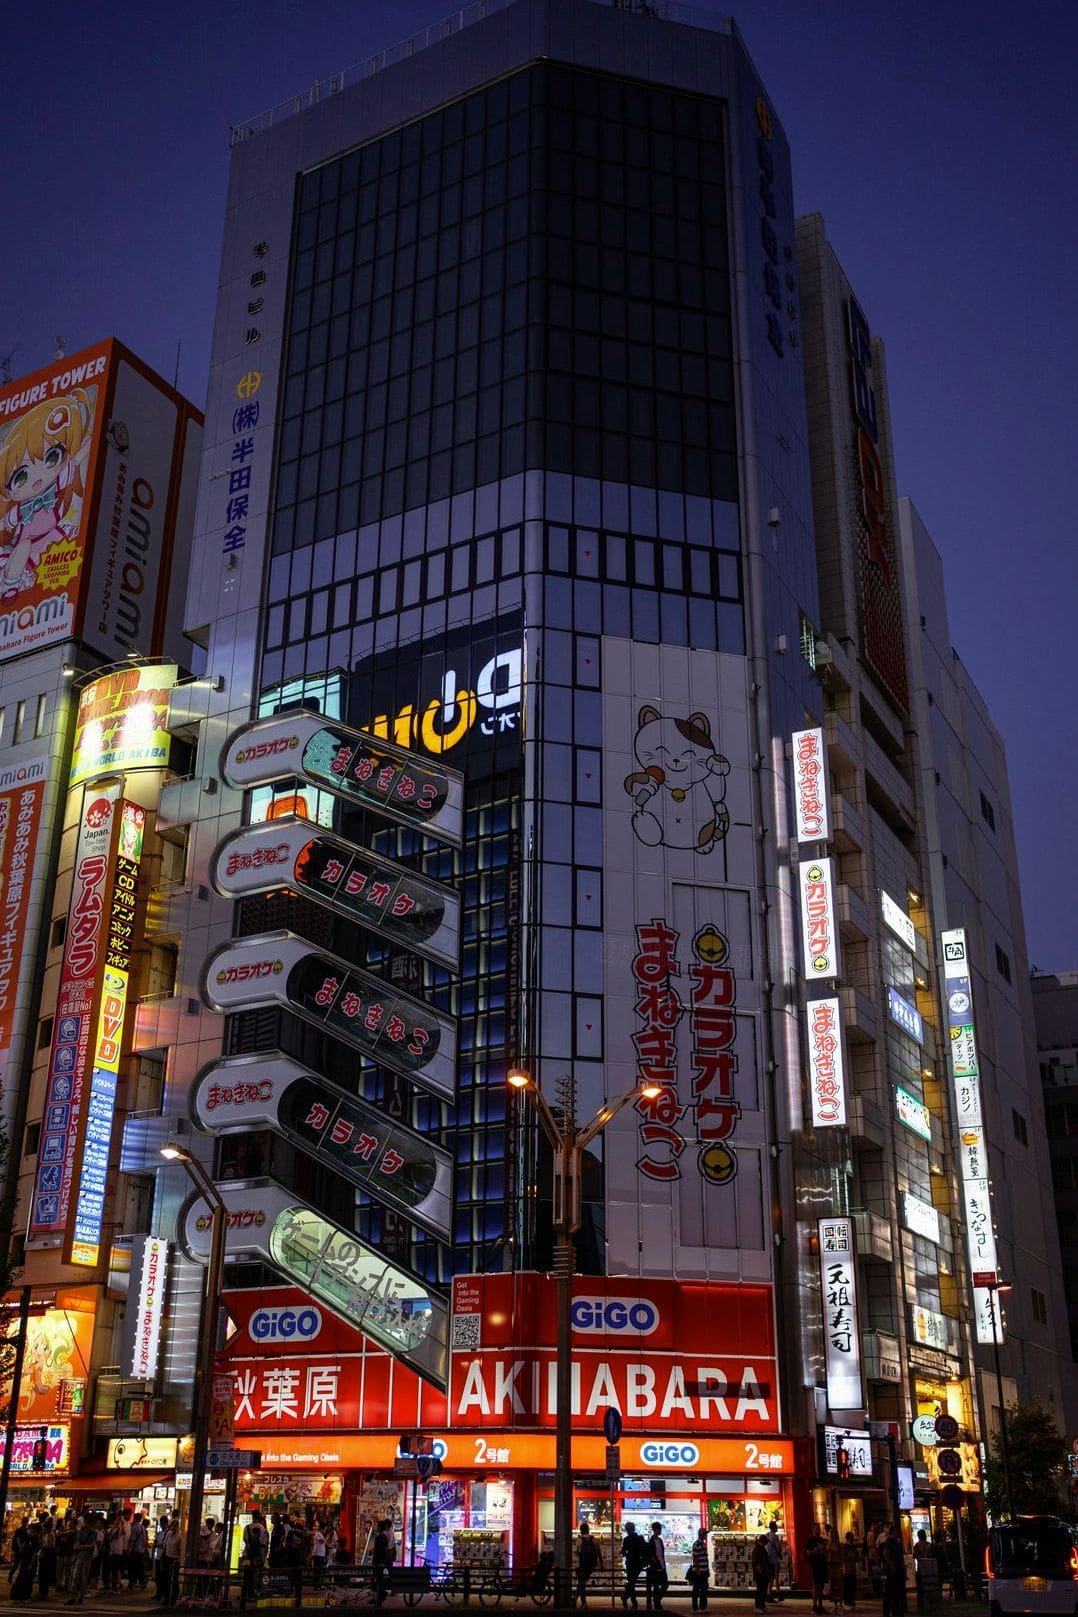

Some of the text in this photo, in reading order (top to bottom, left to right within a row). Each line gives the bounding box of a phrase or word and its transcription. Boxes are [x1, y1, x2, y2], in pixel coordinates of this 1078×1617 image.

[52, 355, 107, 394] TOWER
[44, 549, 78, 566] AMICO
[114, 478, 154, 648] amiami
[23, 631, 46, 644] Figure
[47, 622, 68, 636] Tower
[245, 738, 289, 762] カラオケ
[331, 747, 438, 808] まねきねこ
[797, 733, 823, 836] まねきねこ
[118, 858, 138, 877] ゲーム
[226, 844, 290, 877] まねきねこ
[118, 875, 135, 890] CD
[321, 858, 415, 916] カラオケ
[67, 855, 107, 977] ラムタラ
[112, 903, 135, 921] アニメ
[805, 881, 829, 957] カラオケ
[110, 921, 132, 937] コミック
[110, 936, 129, 951] ホビー
[225, 960, 273, 983] カラオケ
[97, 994, 124, 1064] DVD
[315, 978, 429, 1055] まねきねこ
[632, 919, 688, 1181] まねきねこ
[689, 964, 741, 1143] カラオケ
[812, 1004, 840, 1121] まねきねこ
[206, 1079, 274, 1112] まねきねこ
[960, 1087, 971, 1112] カジノ
[305, 1103, 404, 1175] カラオケ
[456, 1297, 480, 1305] Gaming
[457, 1281, 468, 1289] Get
[139, 1252, 158, 1374] カラオケ まねきねこ
[252, 1309, 319, 1339] GiGO
[571, 1300, 655, 1331] GiGO
[826, 1263, 852, 1353] 元祖寿司
[458, 1360, 770, 1420] AKIHABARA
[266, 1453, 340, 1464] into the Gaming Oasis
[474, 1438, 510, 1464] 2号館
[643, 1445, 696, 1463] GiGO
[745, 1443, 783, 1469] 2号館
